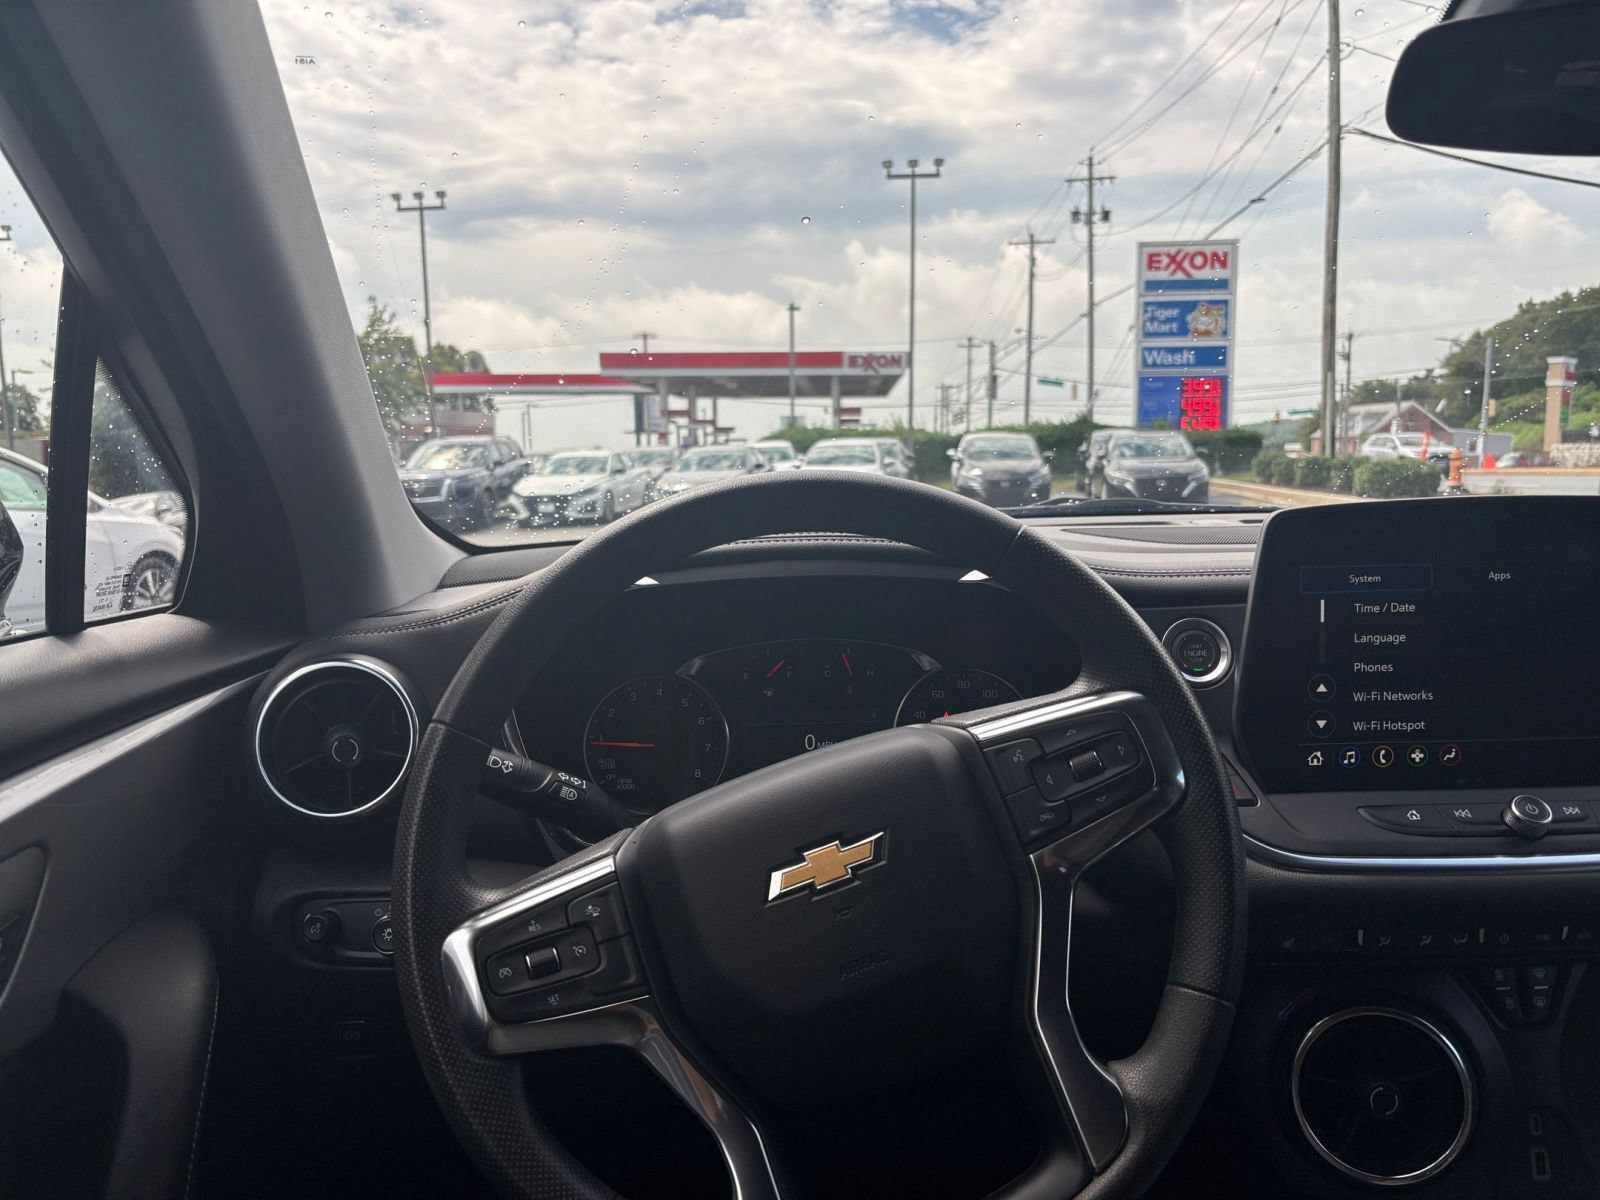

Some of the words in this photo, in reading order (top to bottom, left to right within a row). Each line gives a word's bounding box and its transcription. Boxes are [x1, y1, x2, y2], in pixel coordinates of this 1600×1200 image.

[1146, 249, 1229, 278] EXXON
[1144, 306, 1181, 321] Tiger
[1144, 321, 1178, 333] Mart
[1144, 350, 1195, 365] Wash
[848, 353, 903, 374] EXXON
[1349, 574, 1382, 585] System
[1488, 571, 1511, 582] Apps
[1354, 602, 1381, 613] Time
[1390, 602, 1416, 613] Date
[1354, 632, 1407, 645] Language
[1183, 648, 1209, 657] ENGINE
[1353, 661, 1394, 672] Phones
[957, 680, 970, 689] 80
[630, 692, 637, 701] 3
[656, 688, 663, 697] 4
[931, 690, 944, 699] 60
[982, 689, 998, 699] 100
[1353, 691, 1381, 702] Wi-Fi
[1383, 689, 1434, 701] Networks
[681, 699, 689, 707] 5
[608, 708, 616, 717] 2
[913, 710, 926, 719] 40
[698, 717, 705, 725] 6
[1353, 720, 1381, 731] Wi-Fi
[1383, 720, 1426, 732] Hotspot
[805, 734, 815, 750] 0
[705, 744, 712, 752] 7
[694, 769, 701, 778] 8
